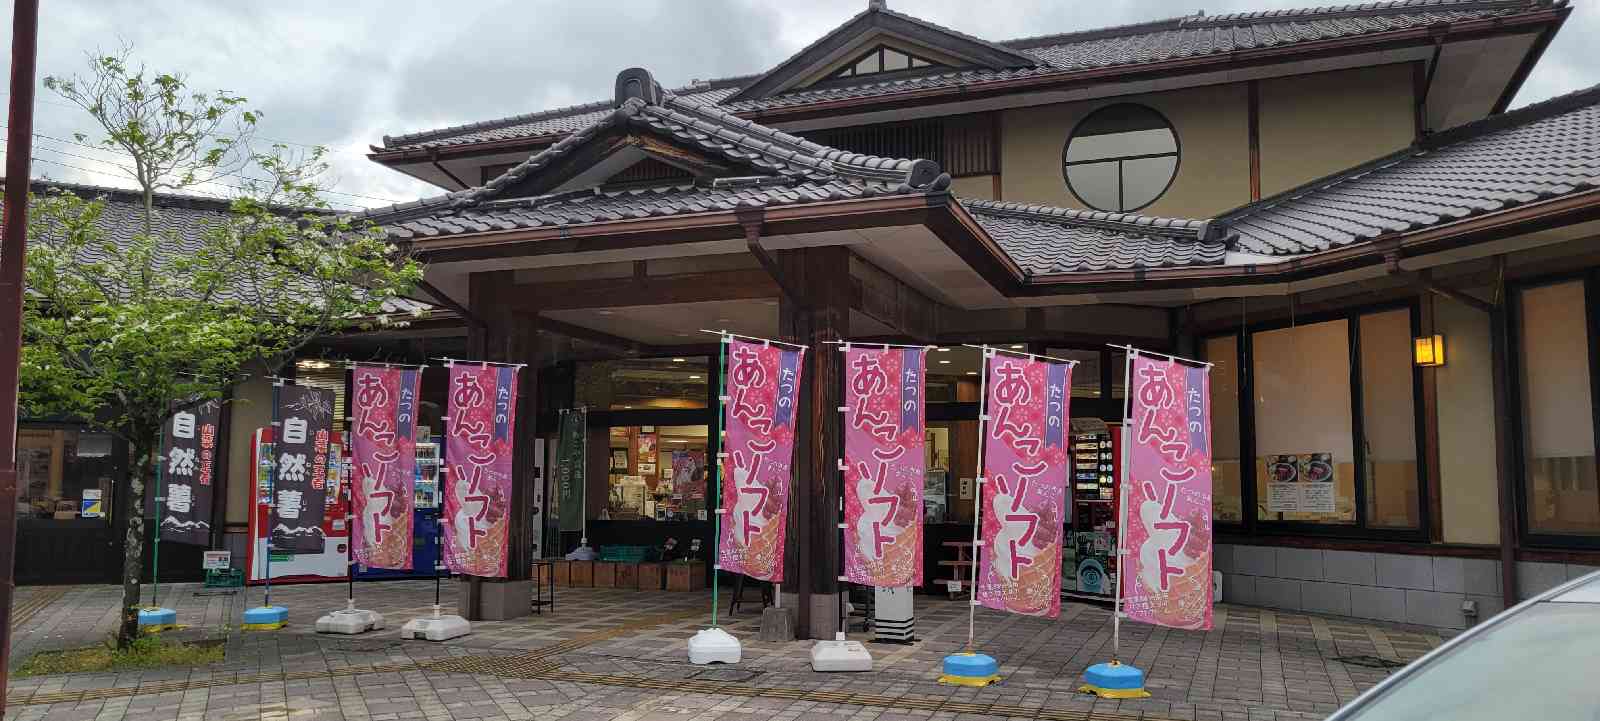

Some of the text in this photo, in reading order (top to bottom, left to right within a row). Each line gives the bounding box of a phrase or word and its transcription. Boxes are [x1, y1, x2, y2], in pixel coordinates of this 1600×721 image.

[398, 387, 414, 424] たつの
[495, 385, 511, 424] たつの
[778, 367, 796, 409] たつの
[903, 367, 918, 413] たつの
[1048, 383, 1064, 428] たつの
[1188, 386, 1203, 433] たつの
[166, 410, 197, 513] 自然薯
[276, 416, 310, 519] 自然薯
[357, 372, 400, 546] あんこソフト
[452, 371, 497, 550] あんこソフト
[731, 346, 777, 547] あんこソフト
[851, 353, 906, 560] あんこソフト
[991, 360, 1049, 581] あんこソフト
[1137, 362, 1196, 593] あんこソフト
